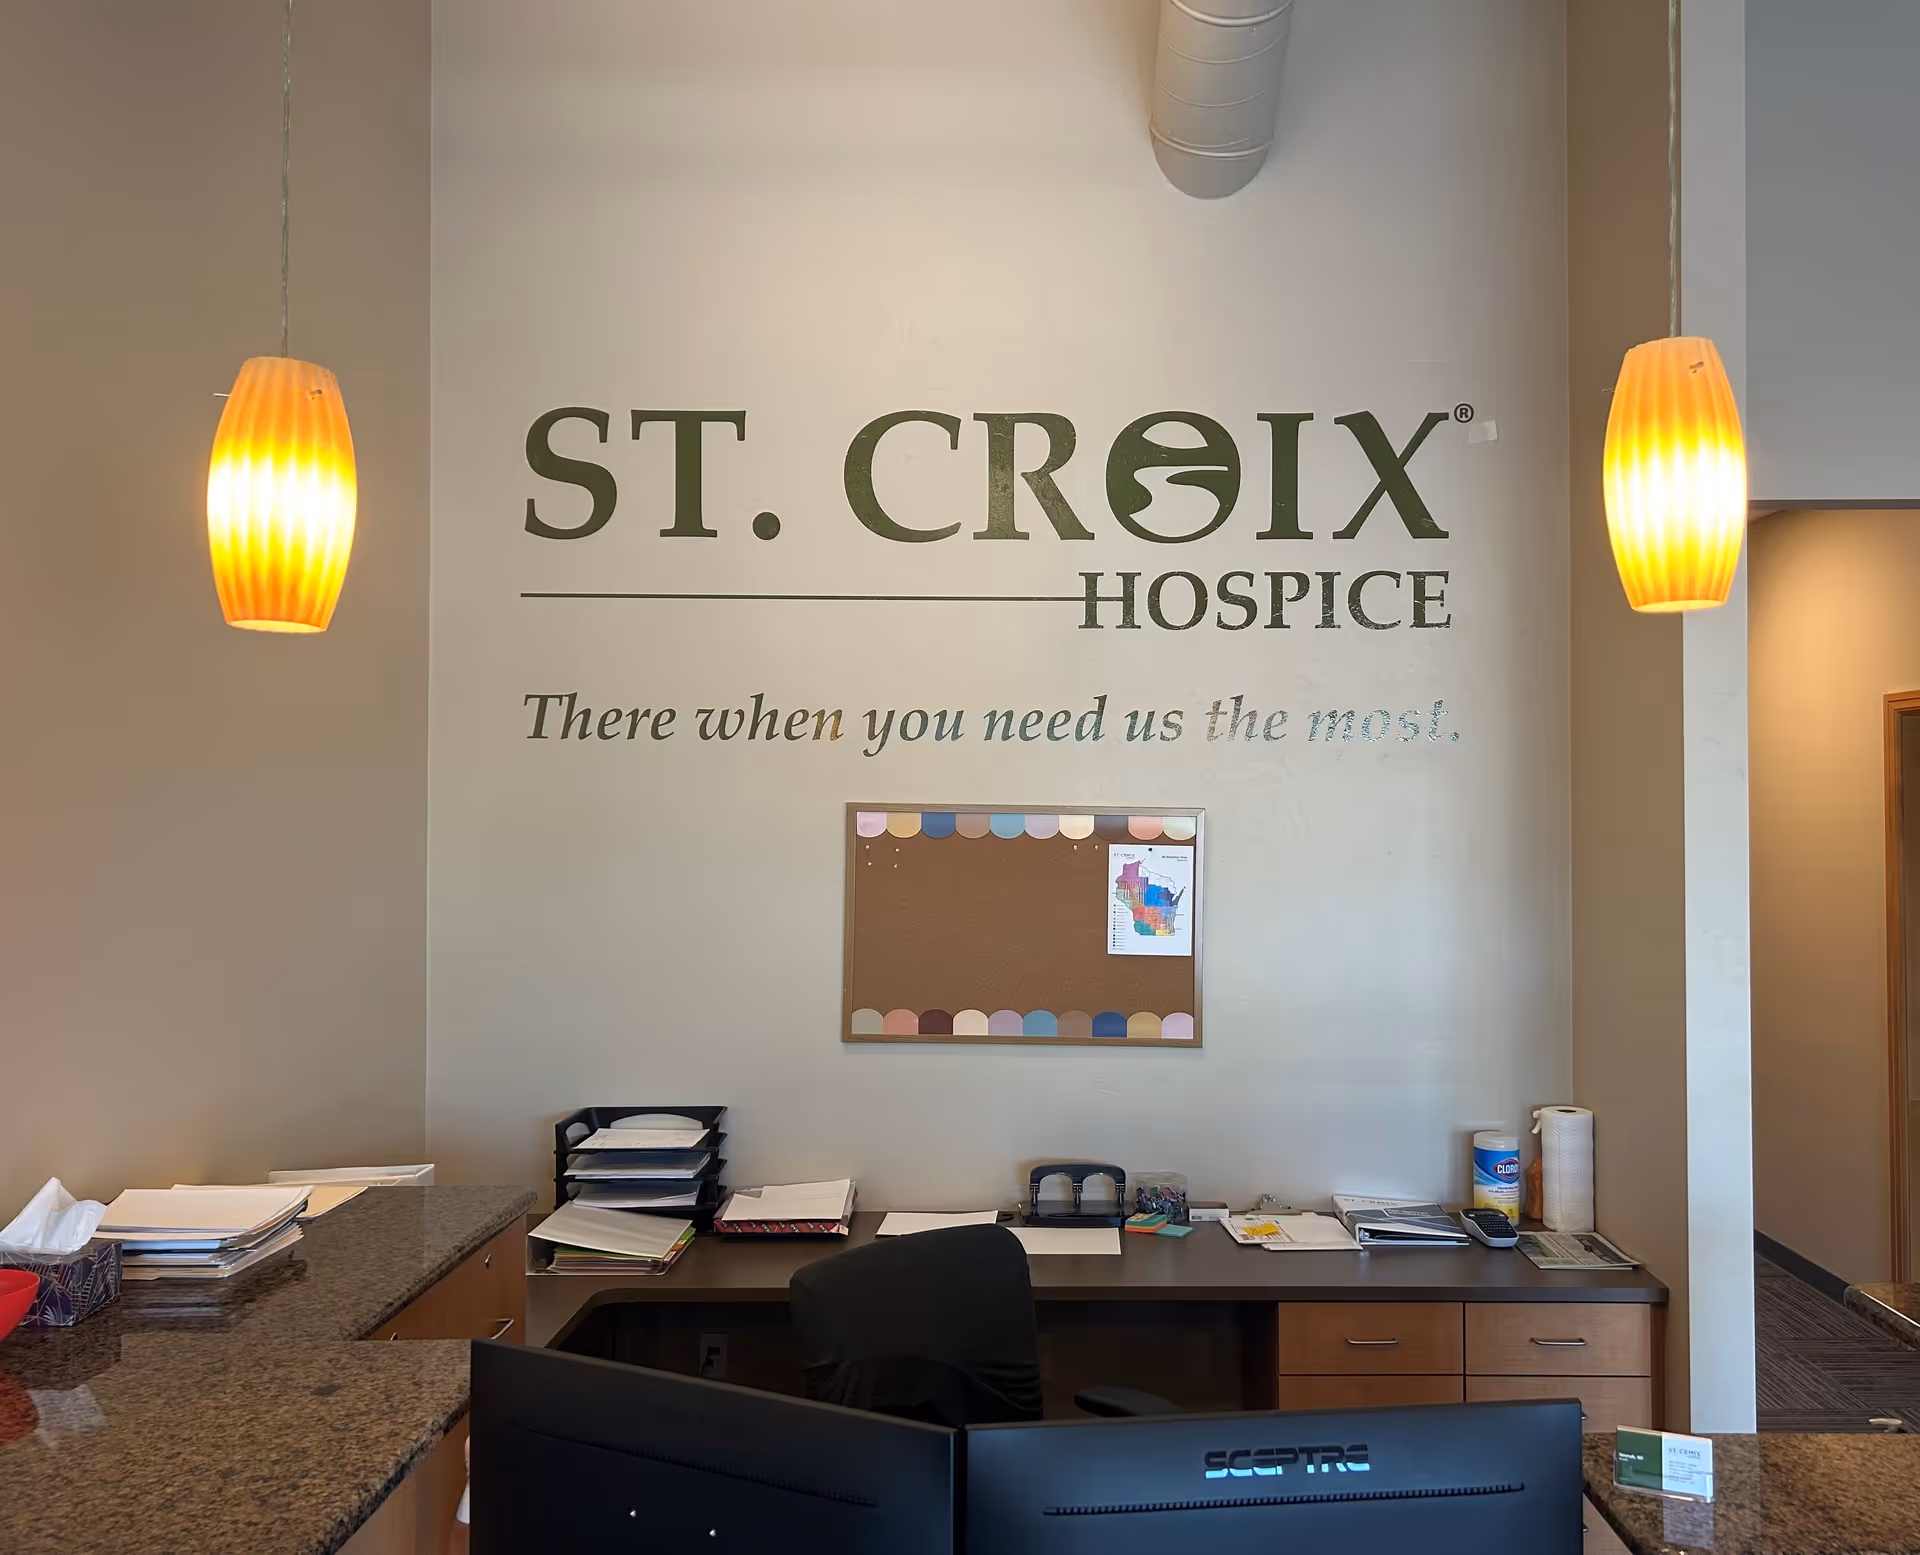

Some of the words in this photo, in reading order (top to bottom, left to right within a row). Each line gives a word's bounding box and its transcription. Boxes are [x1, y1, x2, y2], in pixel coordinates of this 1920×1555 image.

[524, 406, 781, 541] ST.
[1077, 570, 1452, 630] HOSPICE
[523, 691, 676, 742] There
[694, 692, 844, 742] when
[862, 707, 964, 758] you
[983, 694, 1108, 743] need
[1125, 710, 1184, 743] us
[1205, 694, 1288, 743] the
[1307, 698, 1461, 744] most.
[1204, 1444, 1371, 1479] SCEPTRE
